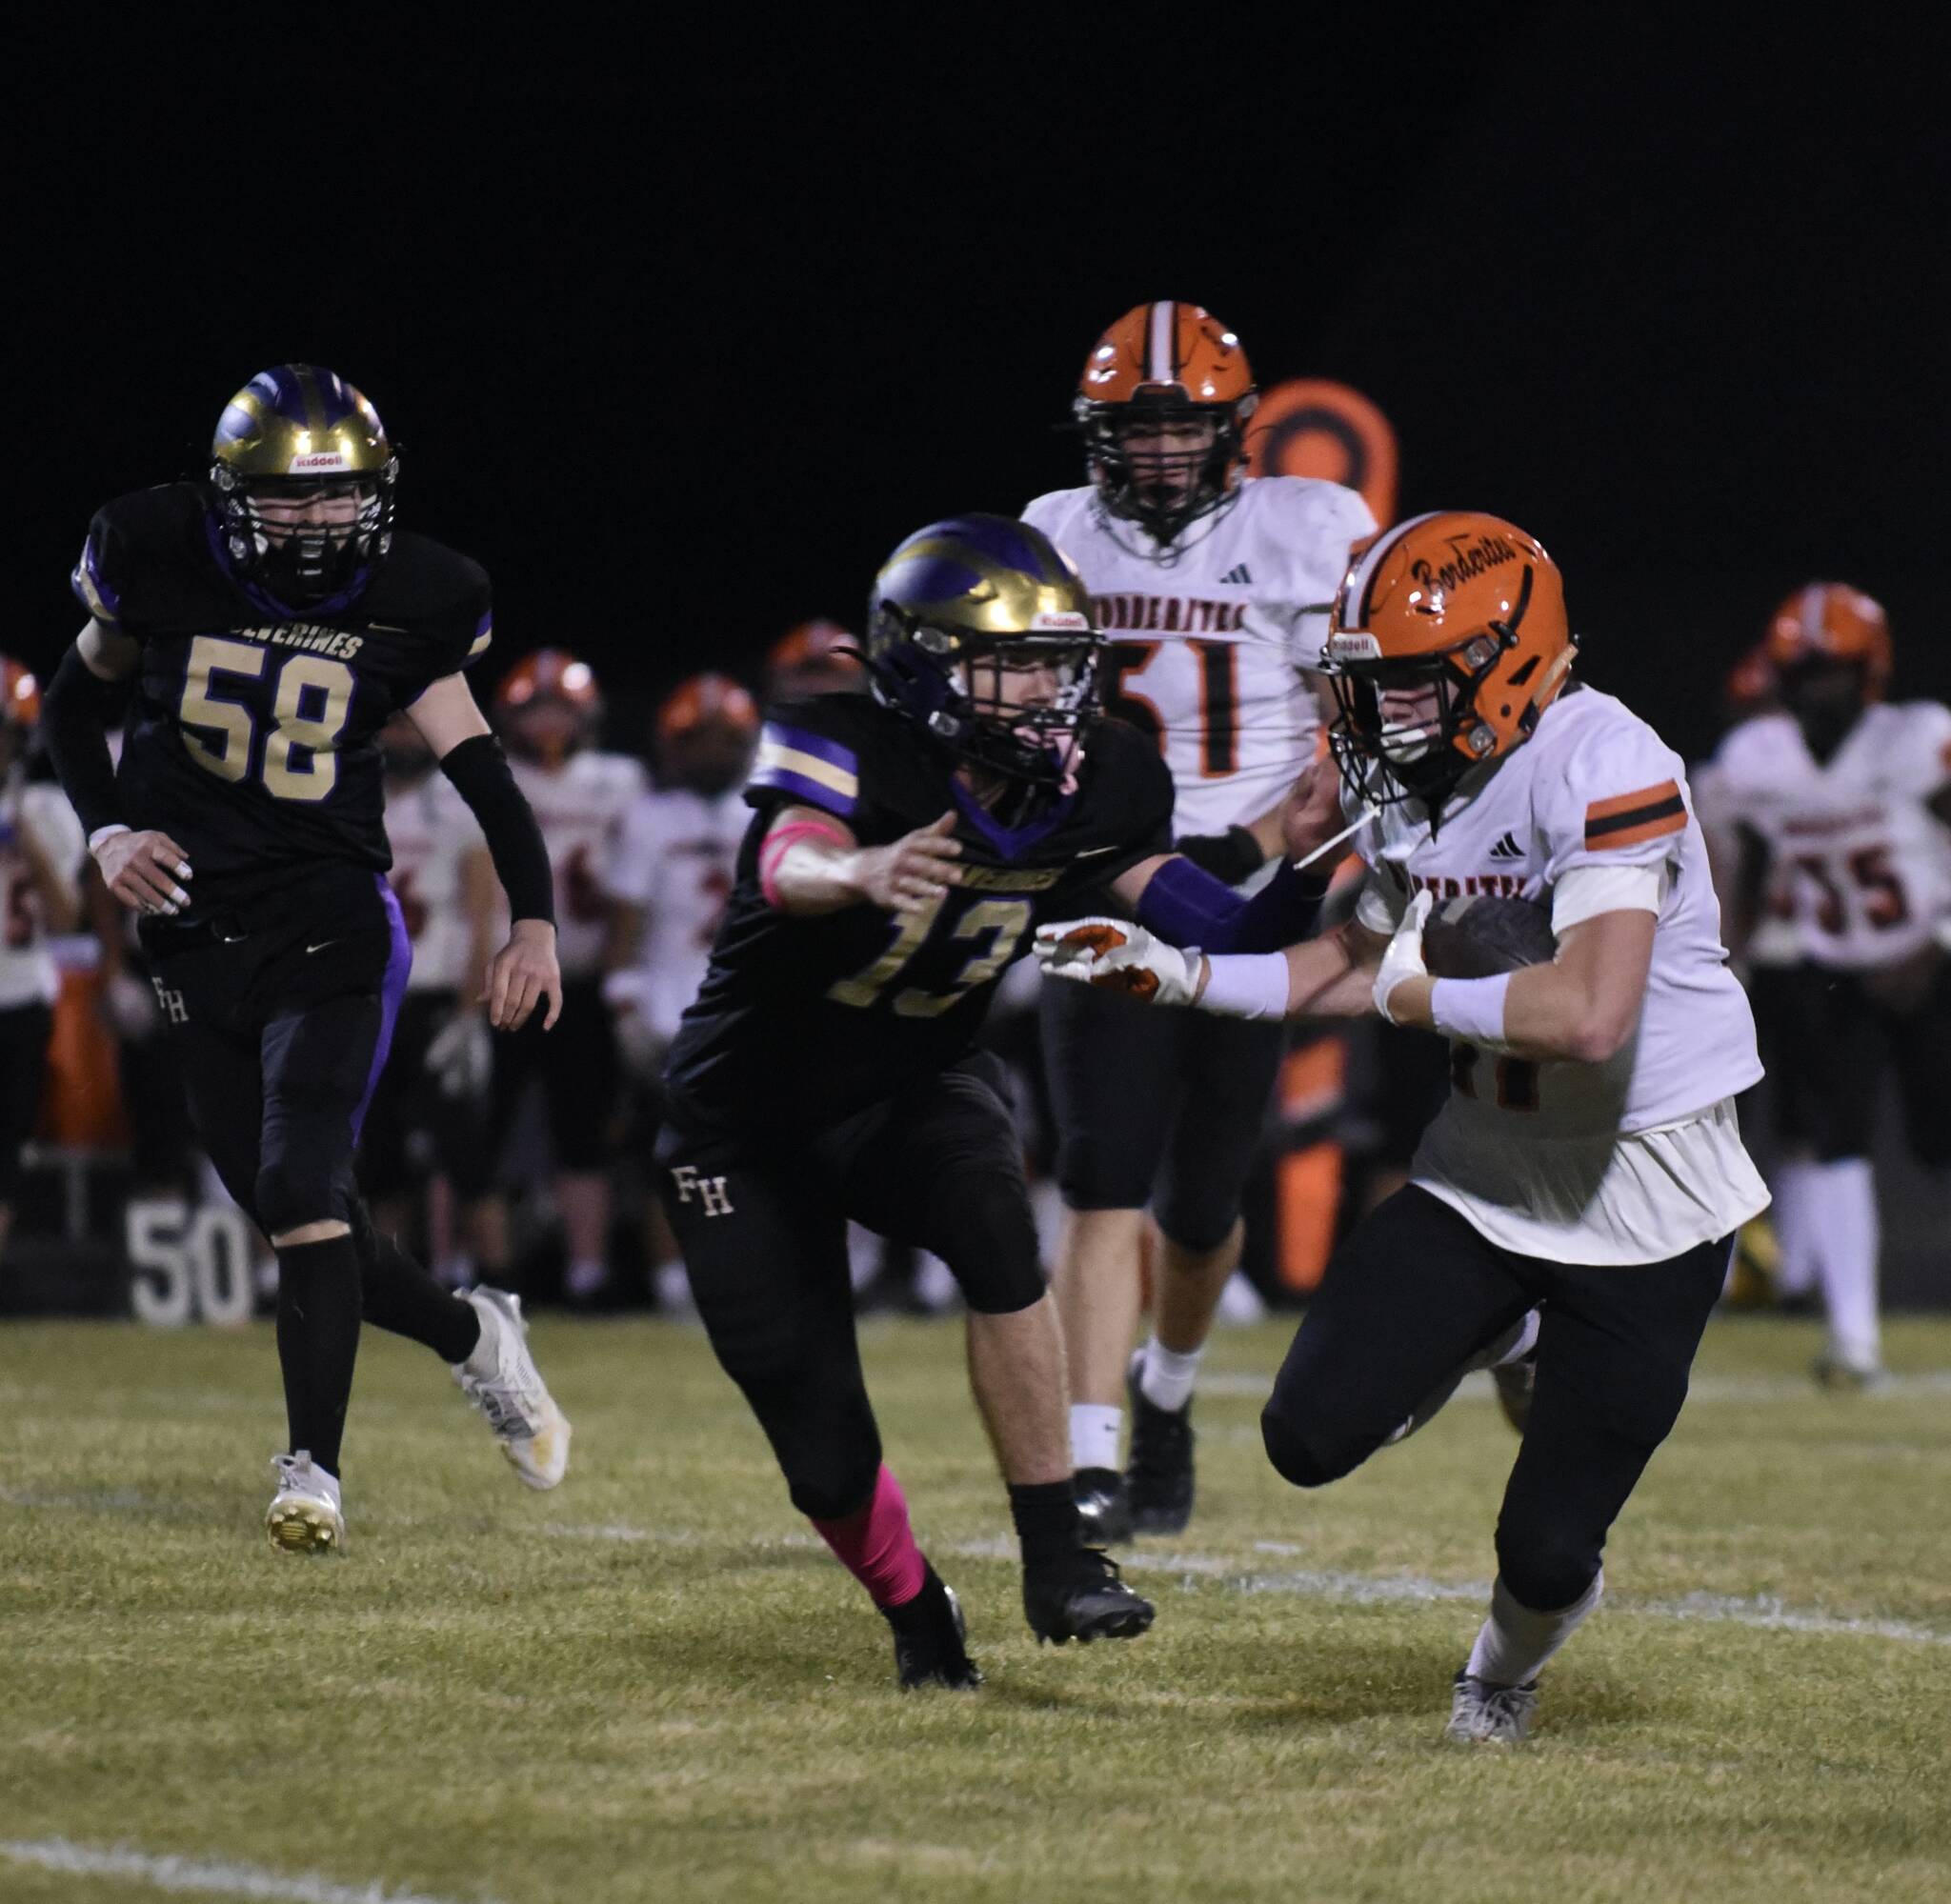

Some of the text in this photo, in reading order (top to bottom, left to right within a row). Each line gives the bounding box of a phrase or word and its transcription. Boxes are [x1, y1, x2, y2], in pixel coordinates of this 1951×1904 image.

[230, 621, 365, 660] LVERINES
[1091, 594, 1247, 631] ORDERITES
[178, 633, 357, 803] 58
[1096, 638, 1240, 780] 51
[825, 892, 1035, 1018] 13
[127, 1201, 252, 1326] 50
